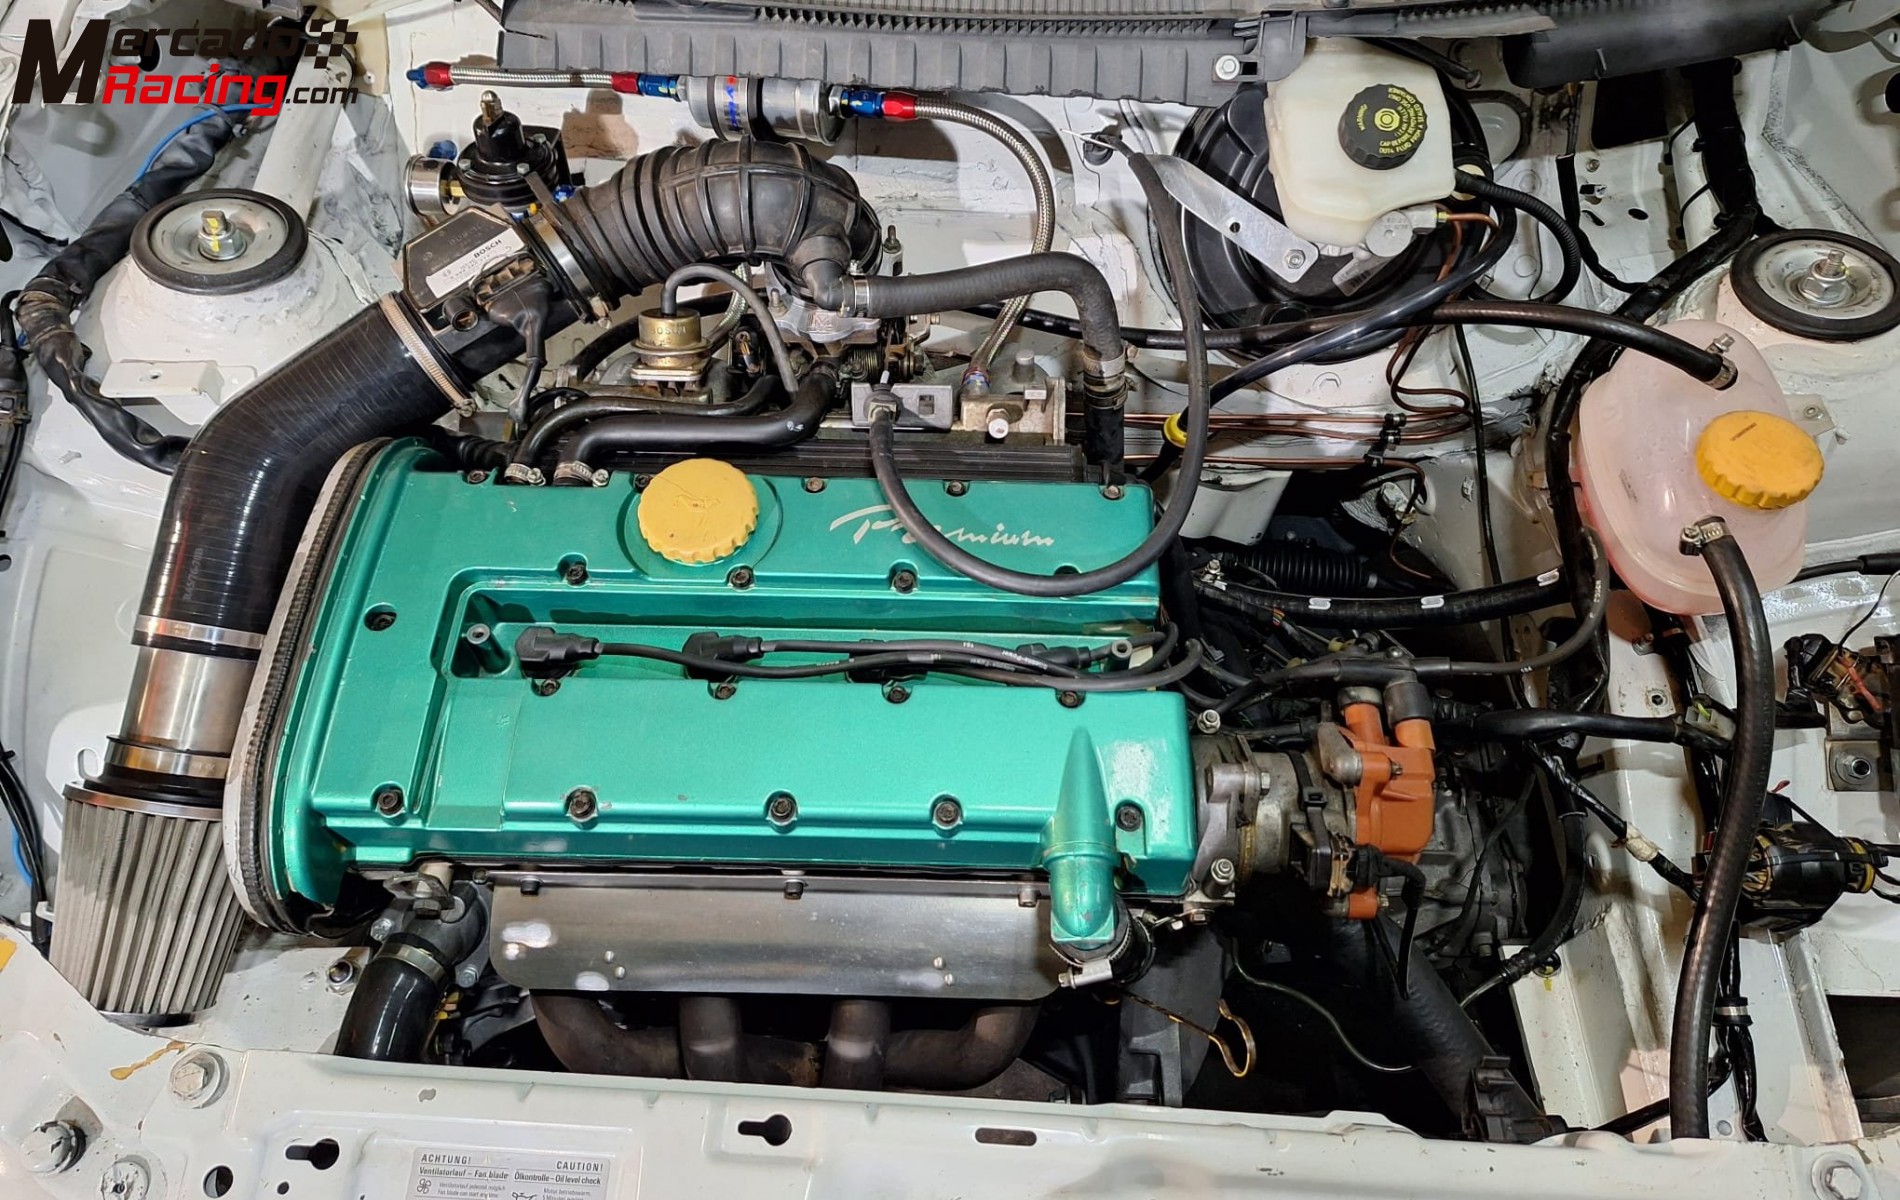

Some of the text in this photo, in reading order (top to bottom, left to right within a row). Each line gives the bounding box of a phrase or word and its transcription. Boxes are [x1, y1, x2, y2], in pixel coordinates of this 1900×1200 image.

[473, 239, 502, 259] BOSCH
[421, 1153, 471, 1165] ACHTUNG!
[556, 1160, 604, 1172] CAUTION!
[419, 1166, 467, 1177] Ventilatorlauf
[474, 1169, 487, 1178] Fan
[488, 1170, 510, 1180] blade
[514, 1170, 550, 1182] Ölkontrolle
[555, 1174, 565, 1183] Oil
[565, 1175, 581, 1184] level
[581, 1176, 601, 1185] check
